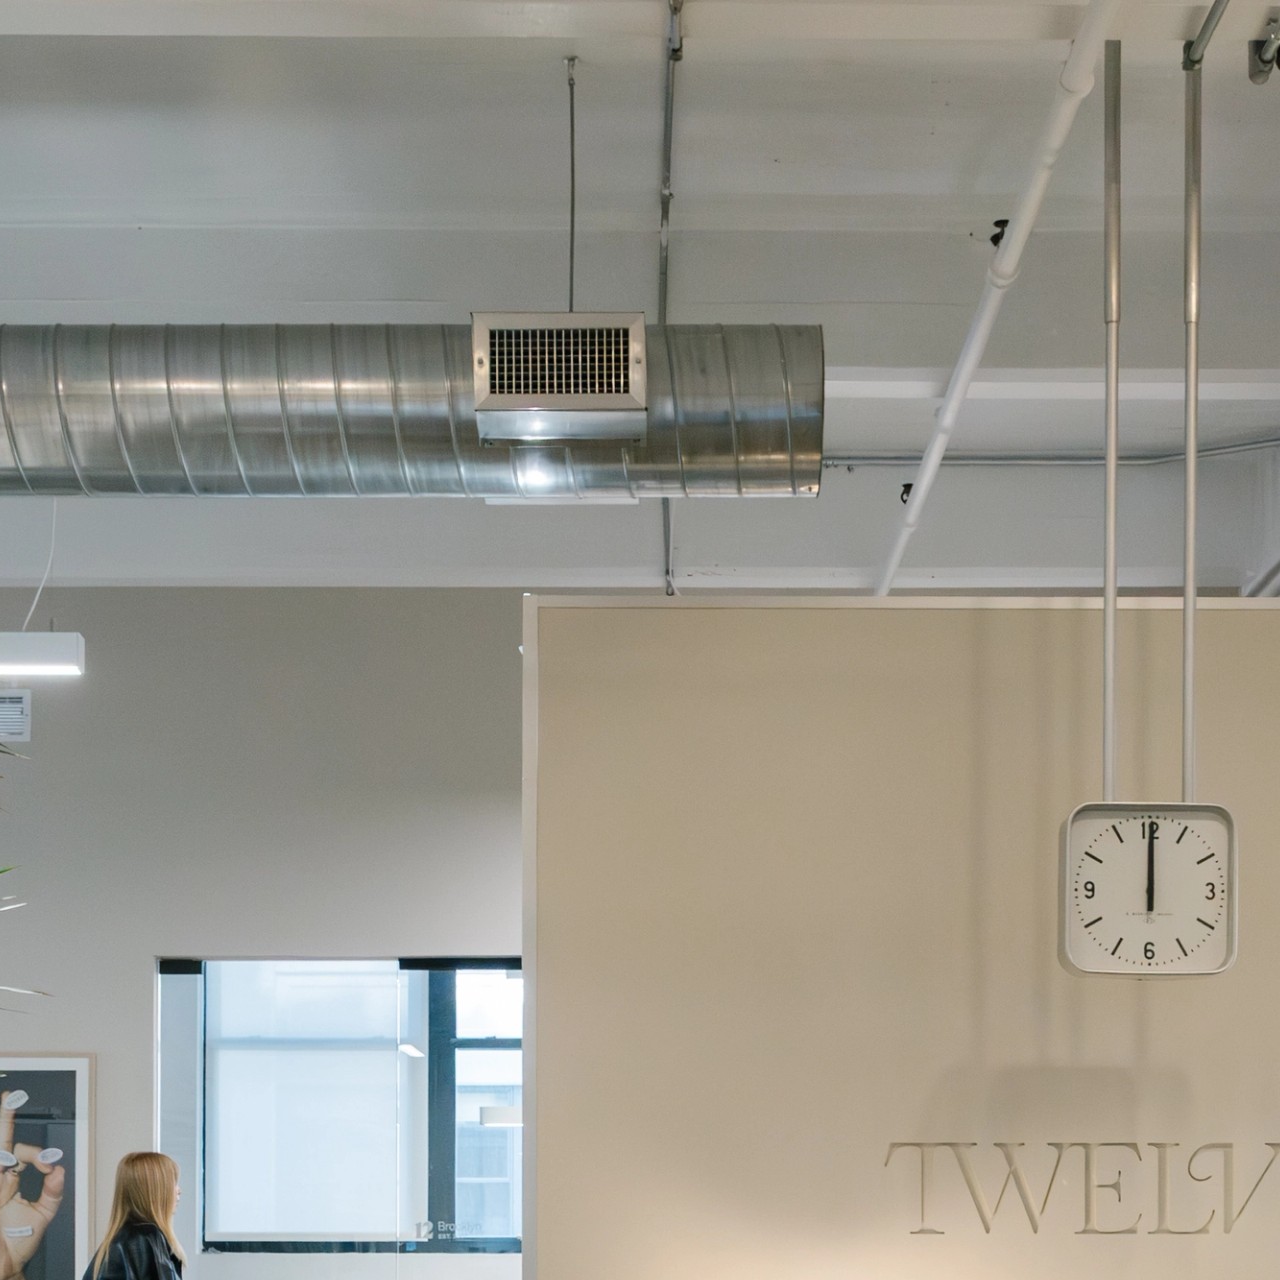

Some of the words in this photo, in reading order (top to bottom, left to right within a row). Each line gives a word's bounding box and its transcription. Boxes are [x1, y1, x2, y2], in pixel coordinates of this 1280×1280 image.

[1083, 881, 1095, 899] 9
[1205, 882, 1216, 900] 3
[1144, 942, 1155, 960] 6
